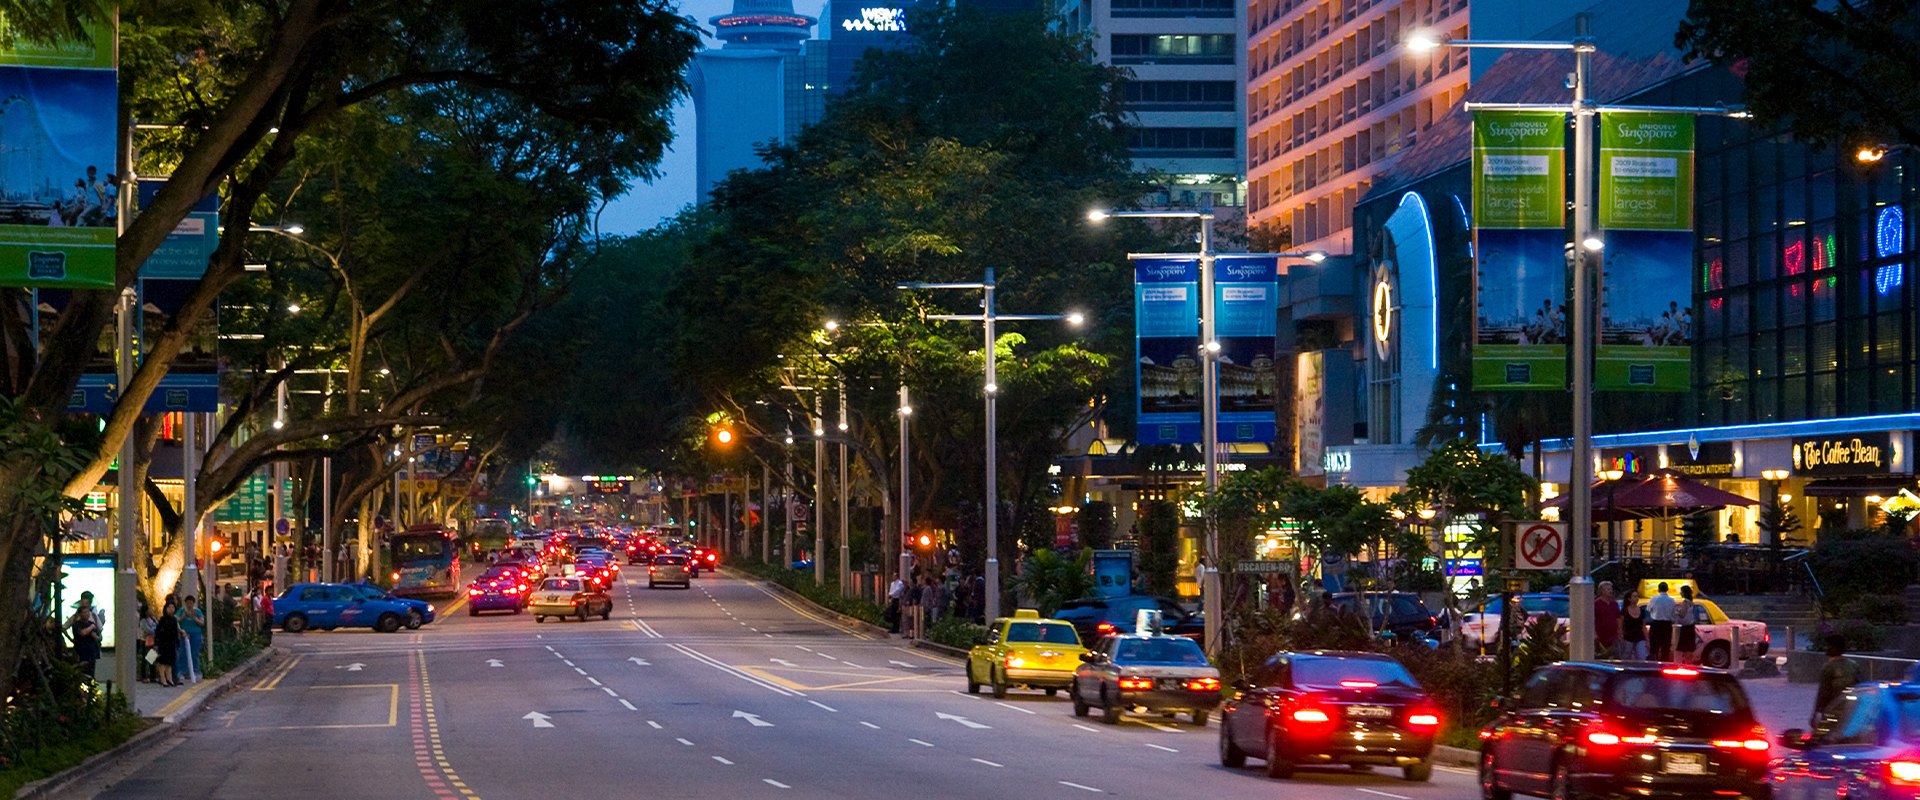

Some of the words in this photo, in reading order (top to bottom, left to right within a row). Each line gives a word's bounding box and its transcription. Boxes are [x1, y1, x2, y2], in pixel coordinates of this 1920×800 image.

[1490, 121, 1549, 143] Singapore
[1618, 123, 1678, 145] Singapore
[1615, 159, 1632, 167] 2009
[1640, 167, 1672, 175] Singapore
[1504, 185, 1518, 194] the
[1614, 186, 1631, 195] Ride
[1632, 187, 1645, 196] the
[1487, 194, 1531, 210] largest
[1614, 195, 1658, 213] largest
[169, 246, 183, 255] the
[184, 246, 199, 255] old
[1146, 265, 1186, 280] Singapore
[1227, 265, 1267, 280] Singapore
[1803, 441, 1821, 470] The
[1822, 440, 1850, 465] Coffee
[1850, 438, 1881, 467] Bean
[1690, 465, 1705, 475] PIZZA
[1706, 463, 1733, 475] KITCHEN
